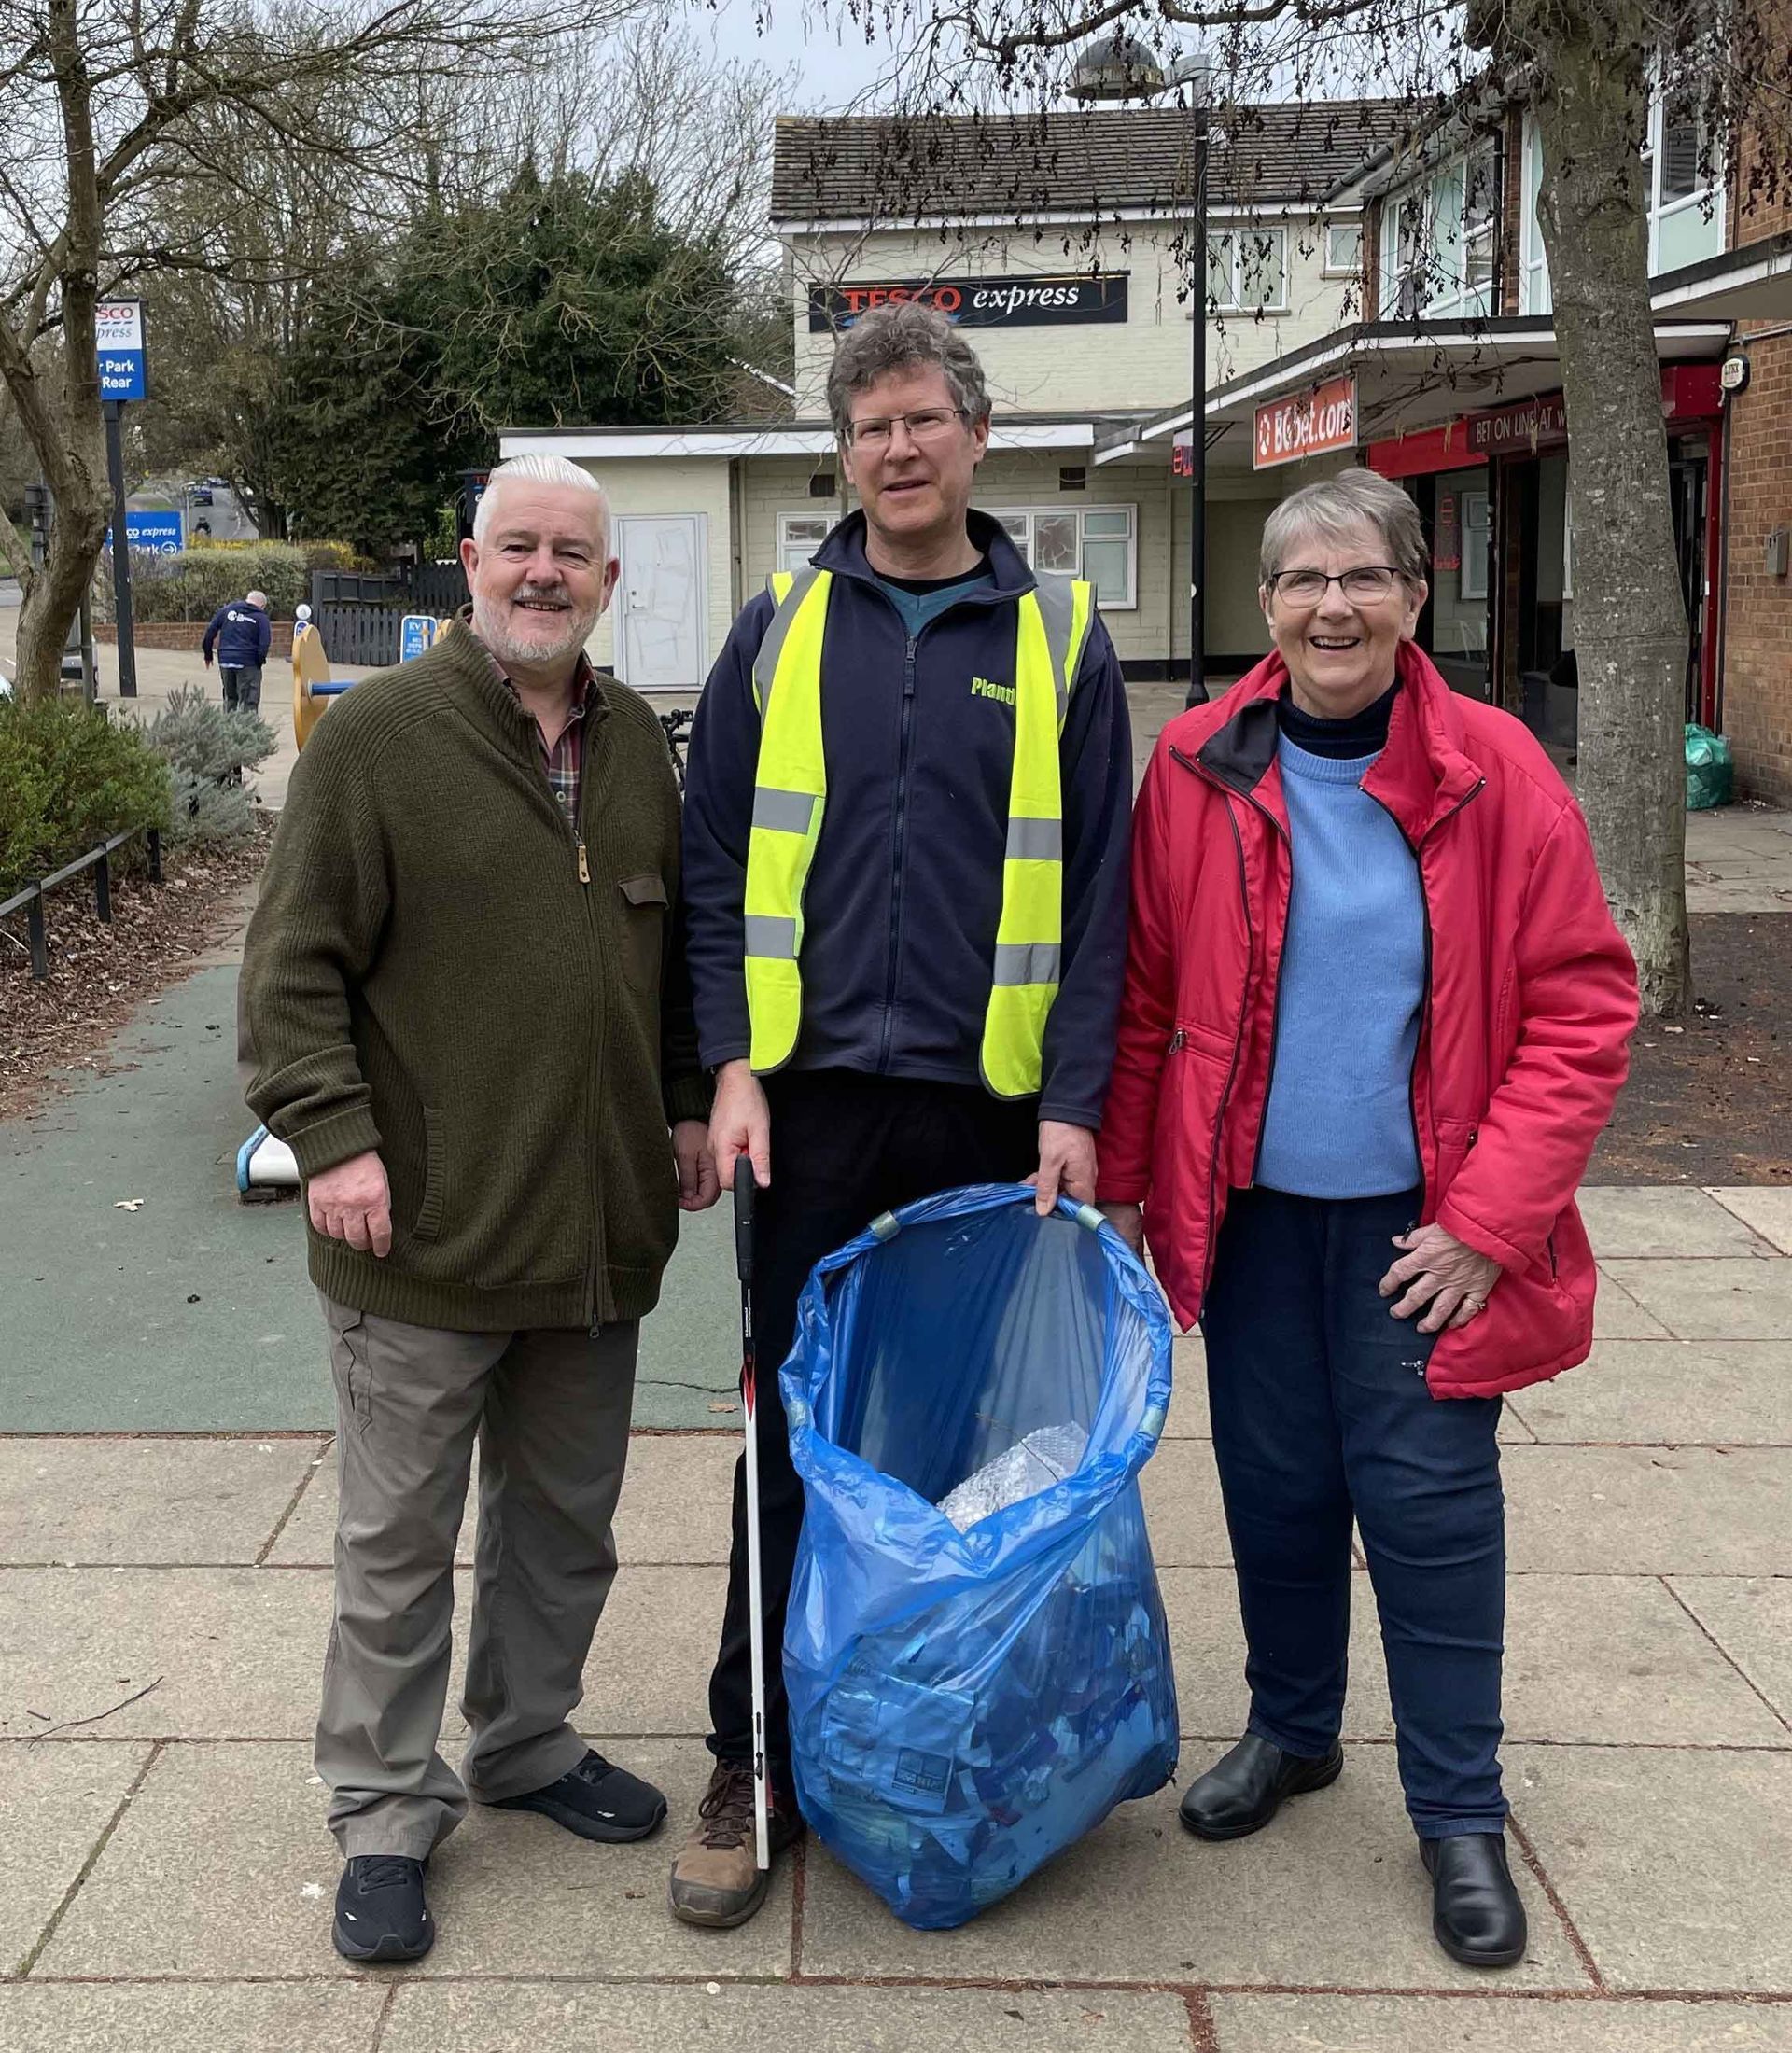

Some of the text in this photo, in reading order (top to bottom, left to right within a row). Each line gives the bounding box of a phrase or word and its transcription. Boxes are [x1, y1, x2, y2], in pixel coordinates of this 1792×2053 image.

[973, 286, 1080, 314] express
[97, 307, 133, 320] SCO
[96, 328, 133, 339] press
[105, 359, 135, 373] Park
[102, 376, 133, 389] Rear
[1477, 419, 1491, 443] BET
[1494, 415, 1510, 440] ON
[1539, 406, 1552, 431] AT
[142, 527, 176, 538] express
